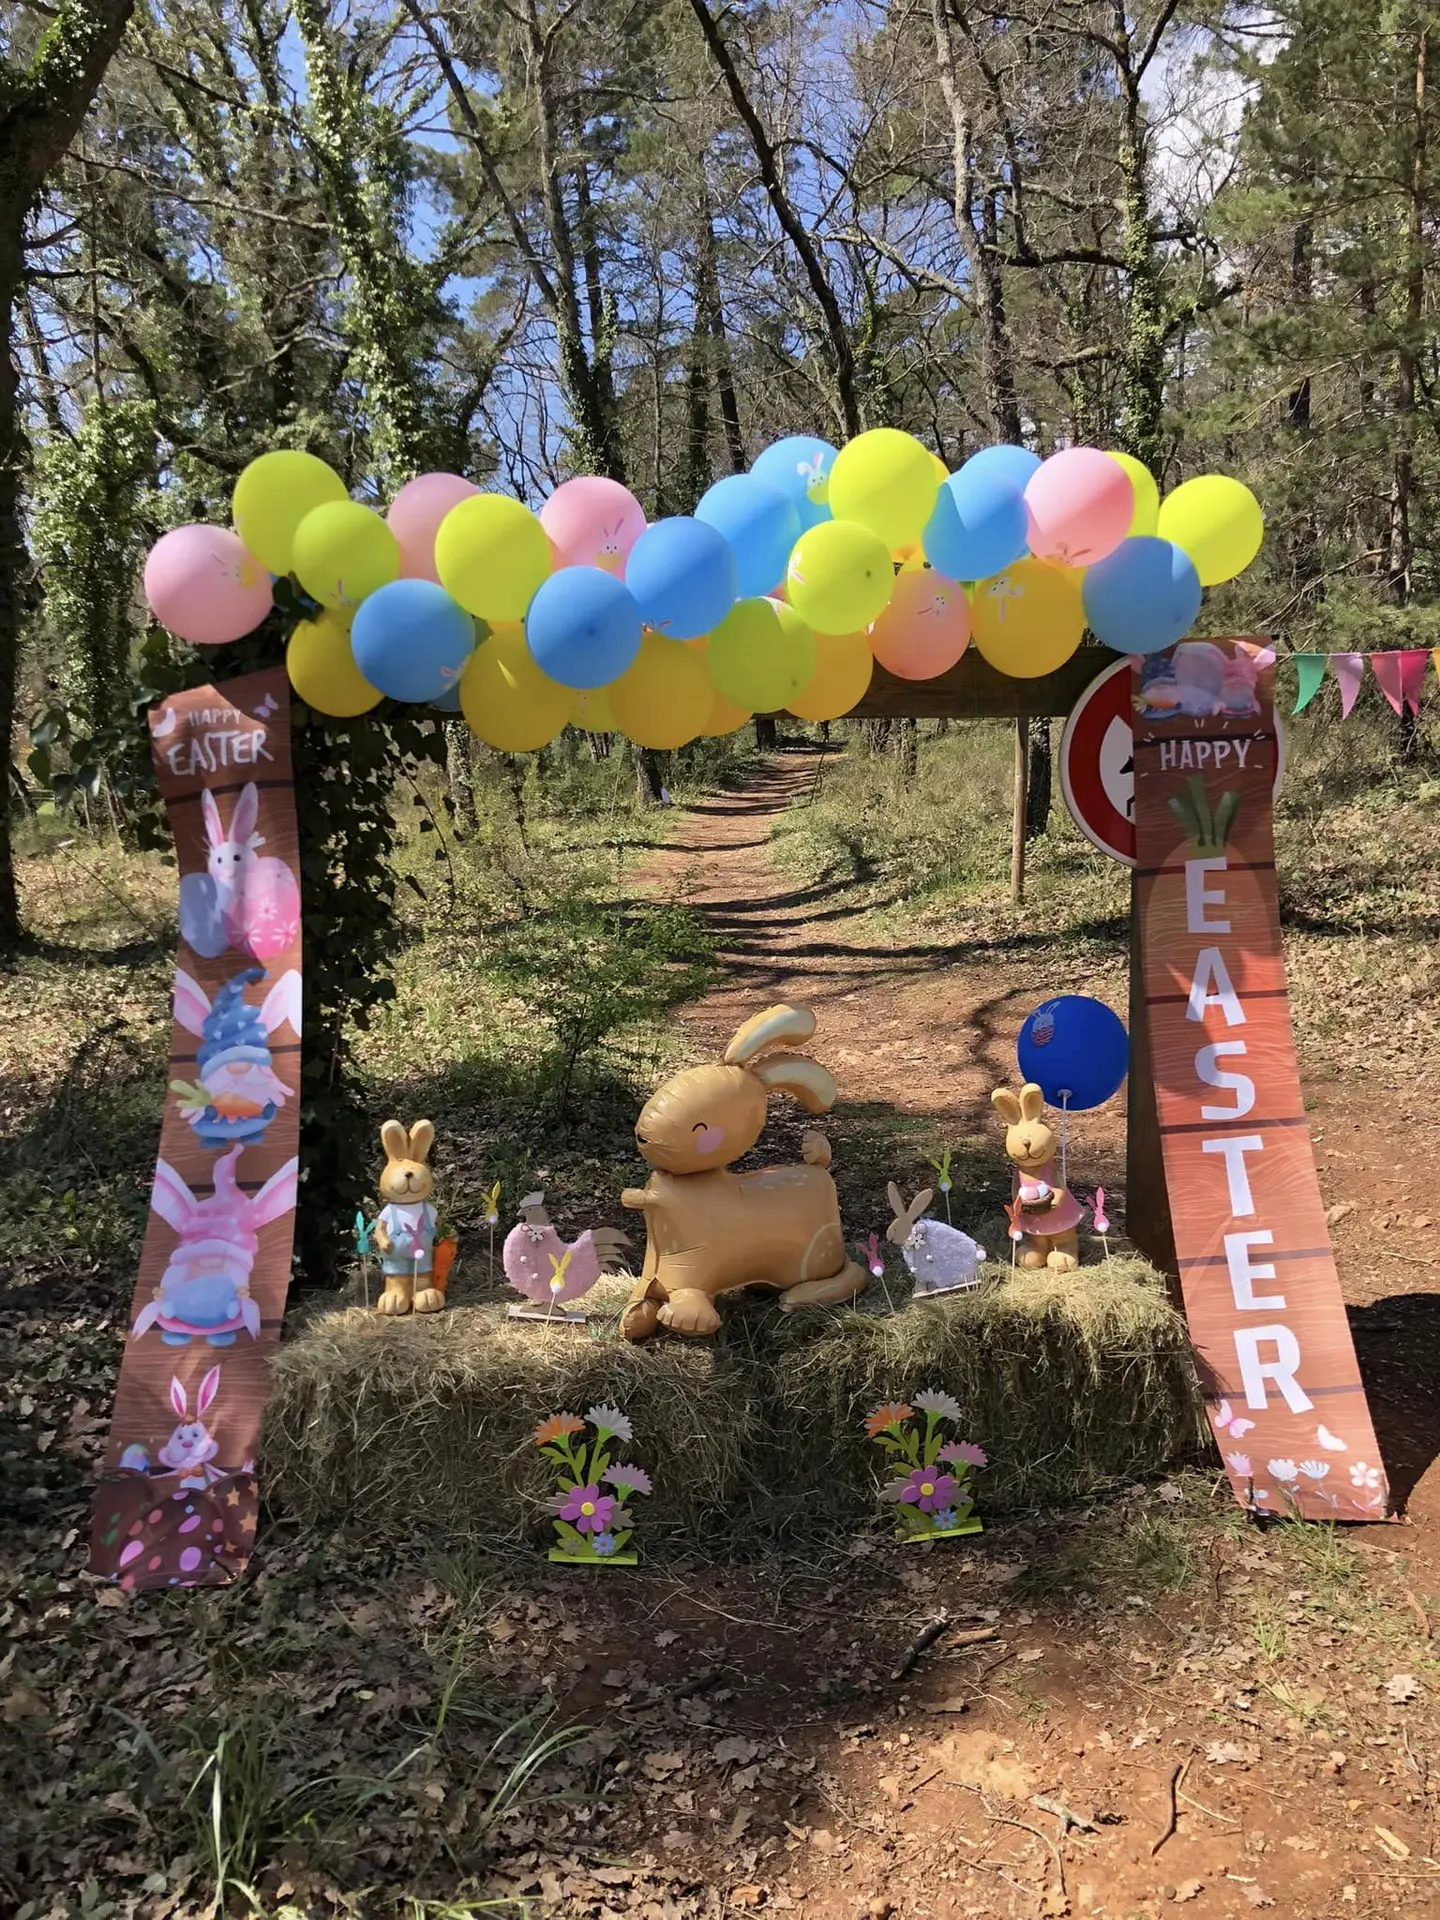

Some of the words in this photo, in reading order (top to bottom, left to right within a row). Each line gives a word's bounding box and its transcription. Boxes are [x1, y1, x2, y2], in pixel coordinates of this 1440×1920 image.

[188, 708, 242, 727] HAPPY
[167, 729, 275, 777] EASTER
[1160, 738, 1251, 771] HAPPY
[1185, 856, 1314, 1414] EASTER
